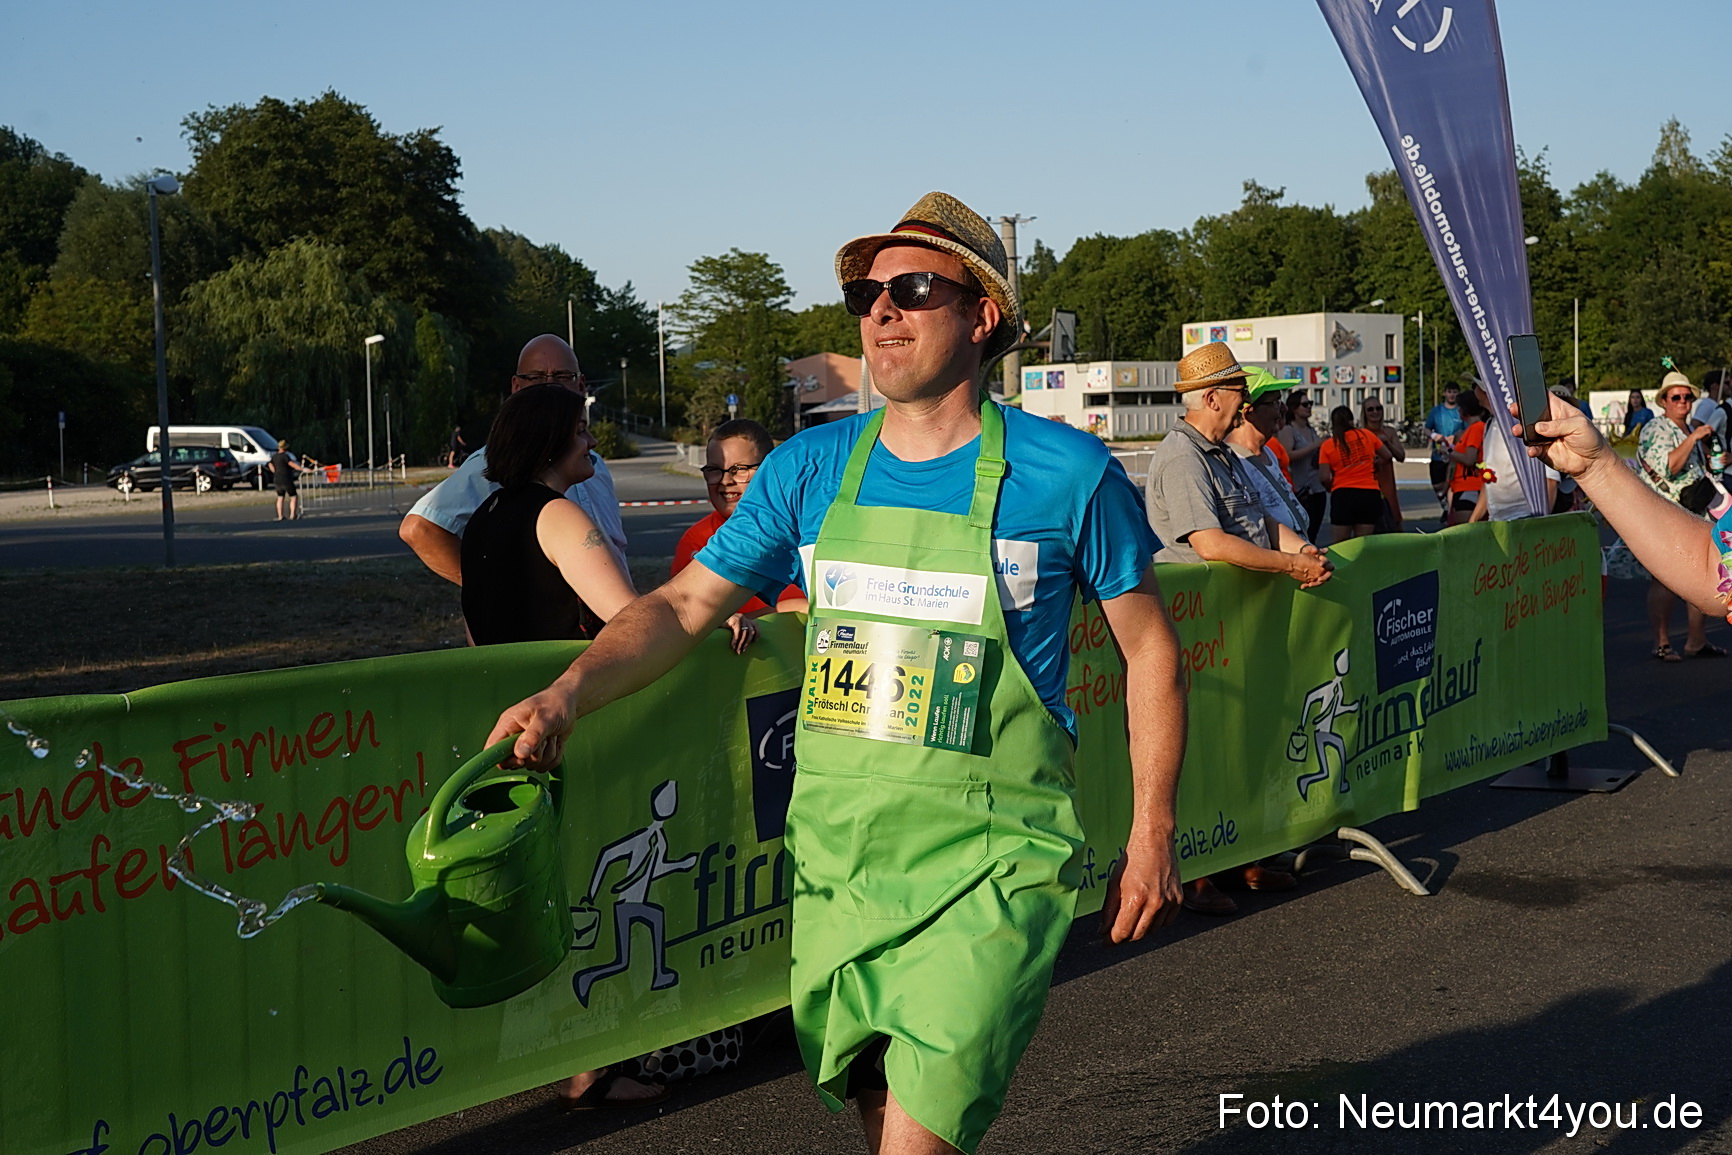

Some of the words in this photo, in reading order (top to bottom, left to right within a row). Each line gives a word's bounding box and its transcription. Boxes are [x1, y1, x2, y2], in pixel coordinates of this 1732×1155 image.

[866, 577, 895, 593] Freie
[898, 581, 970, 599] Grundschule
[865, 592, 877, 602] im
[878, 593, 902, 605] Haus
[903, 596, 915, 607] St.
[917, 598, 949, 609] Marien
[1386, 607, 1434, 638] Fischer
[830, 640, 869, 650] Firmenlauf
[943, 645, 951, 661] AOK
[806, 661, 819, 715] WALK
[904, 674, 925, 727] 2022
[814, 697, 849, 712] Frötschl
[172, 709, 381, 793] Firmen
[0, 834, 195, 941] aufen
